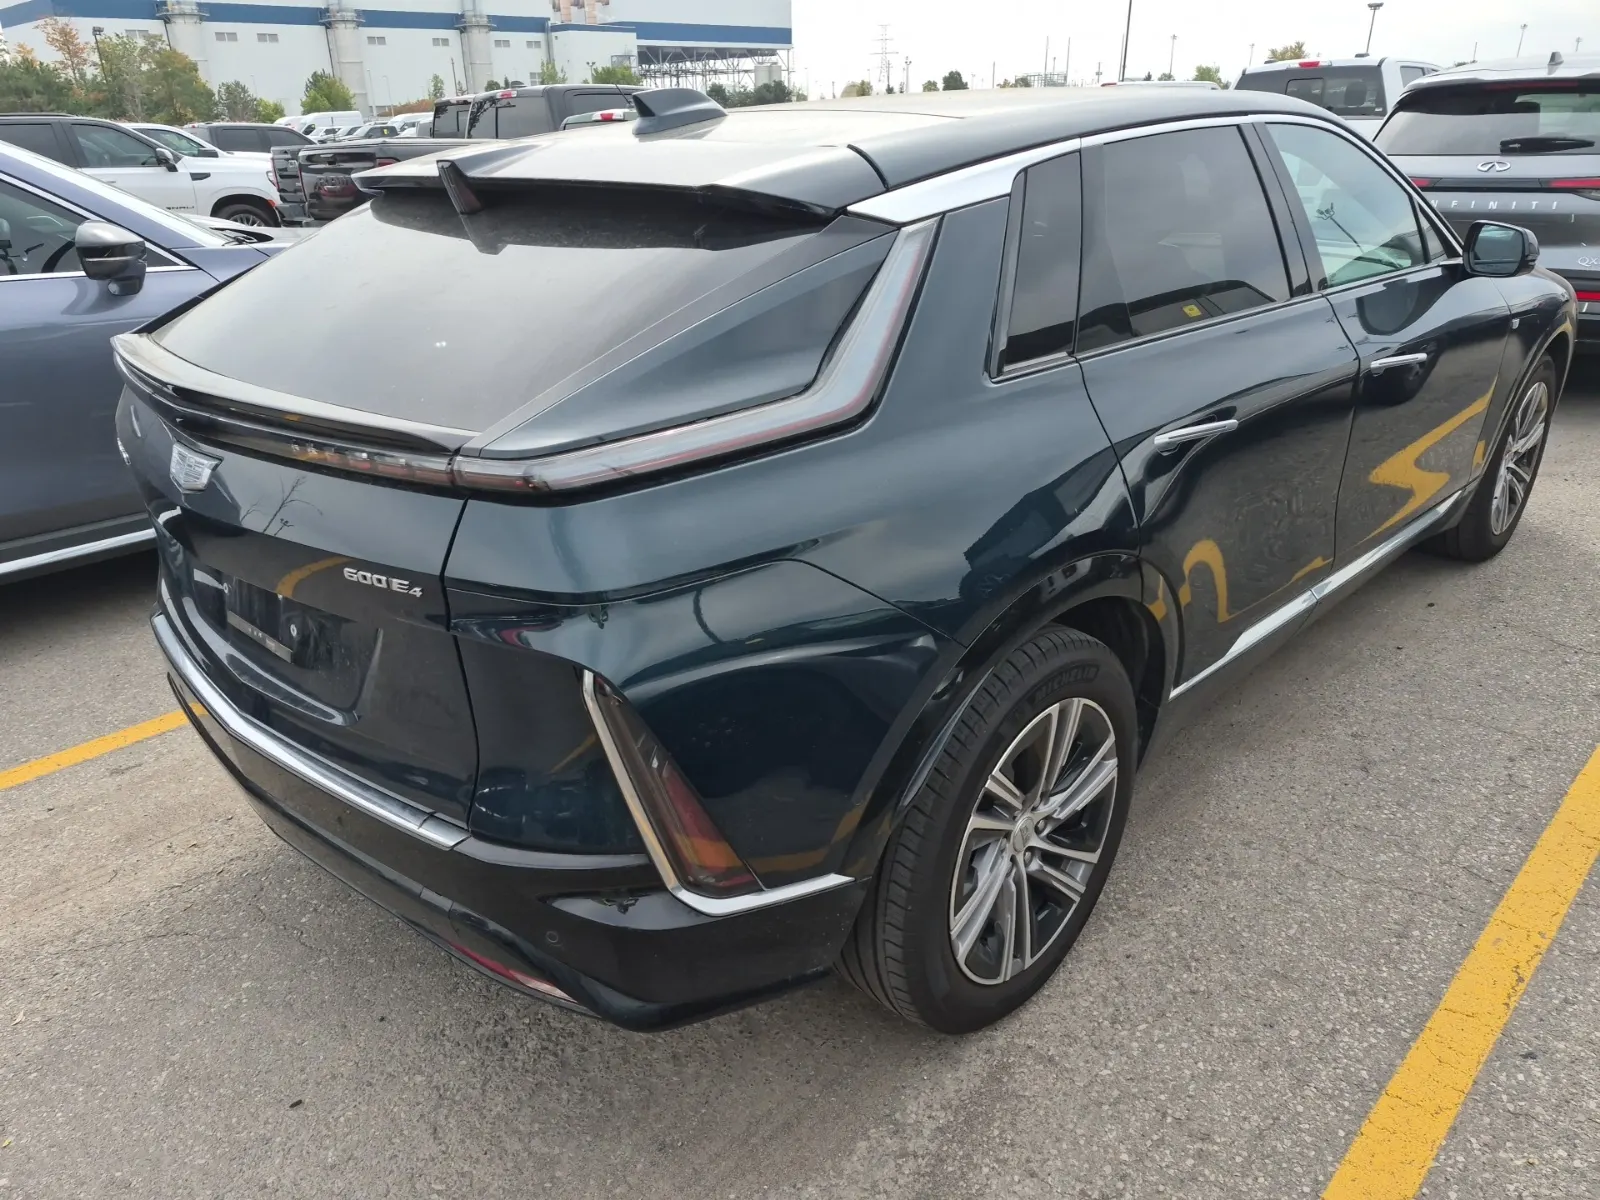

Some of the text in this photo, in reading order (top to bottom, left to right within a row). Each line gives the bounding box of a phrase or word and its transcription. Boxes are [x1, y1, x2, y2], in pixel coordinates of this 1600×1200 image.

[1431, 200, 1557, 210] NFINITI
[1578, 256, 1600, 267] QX
[1035, 665, 1097, 701] MICHELIN
